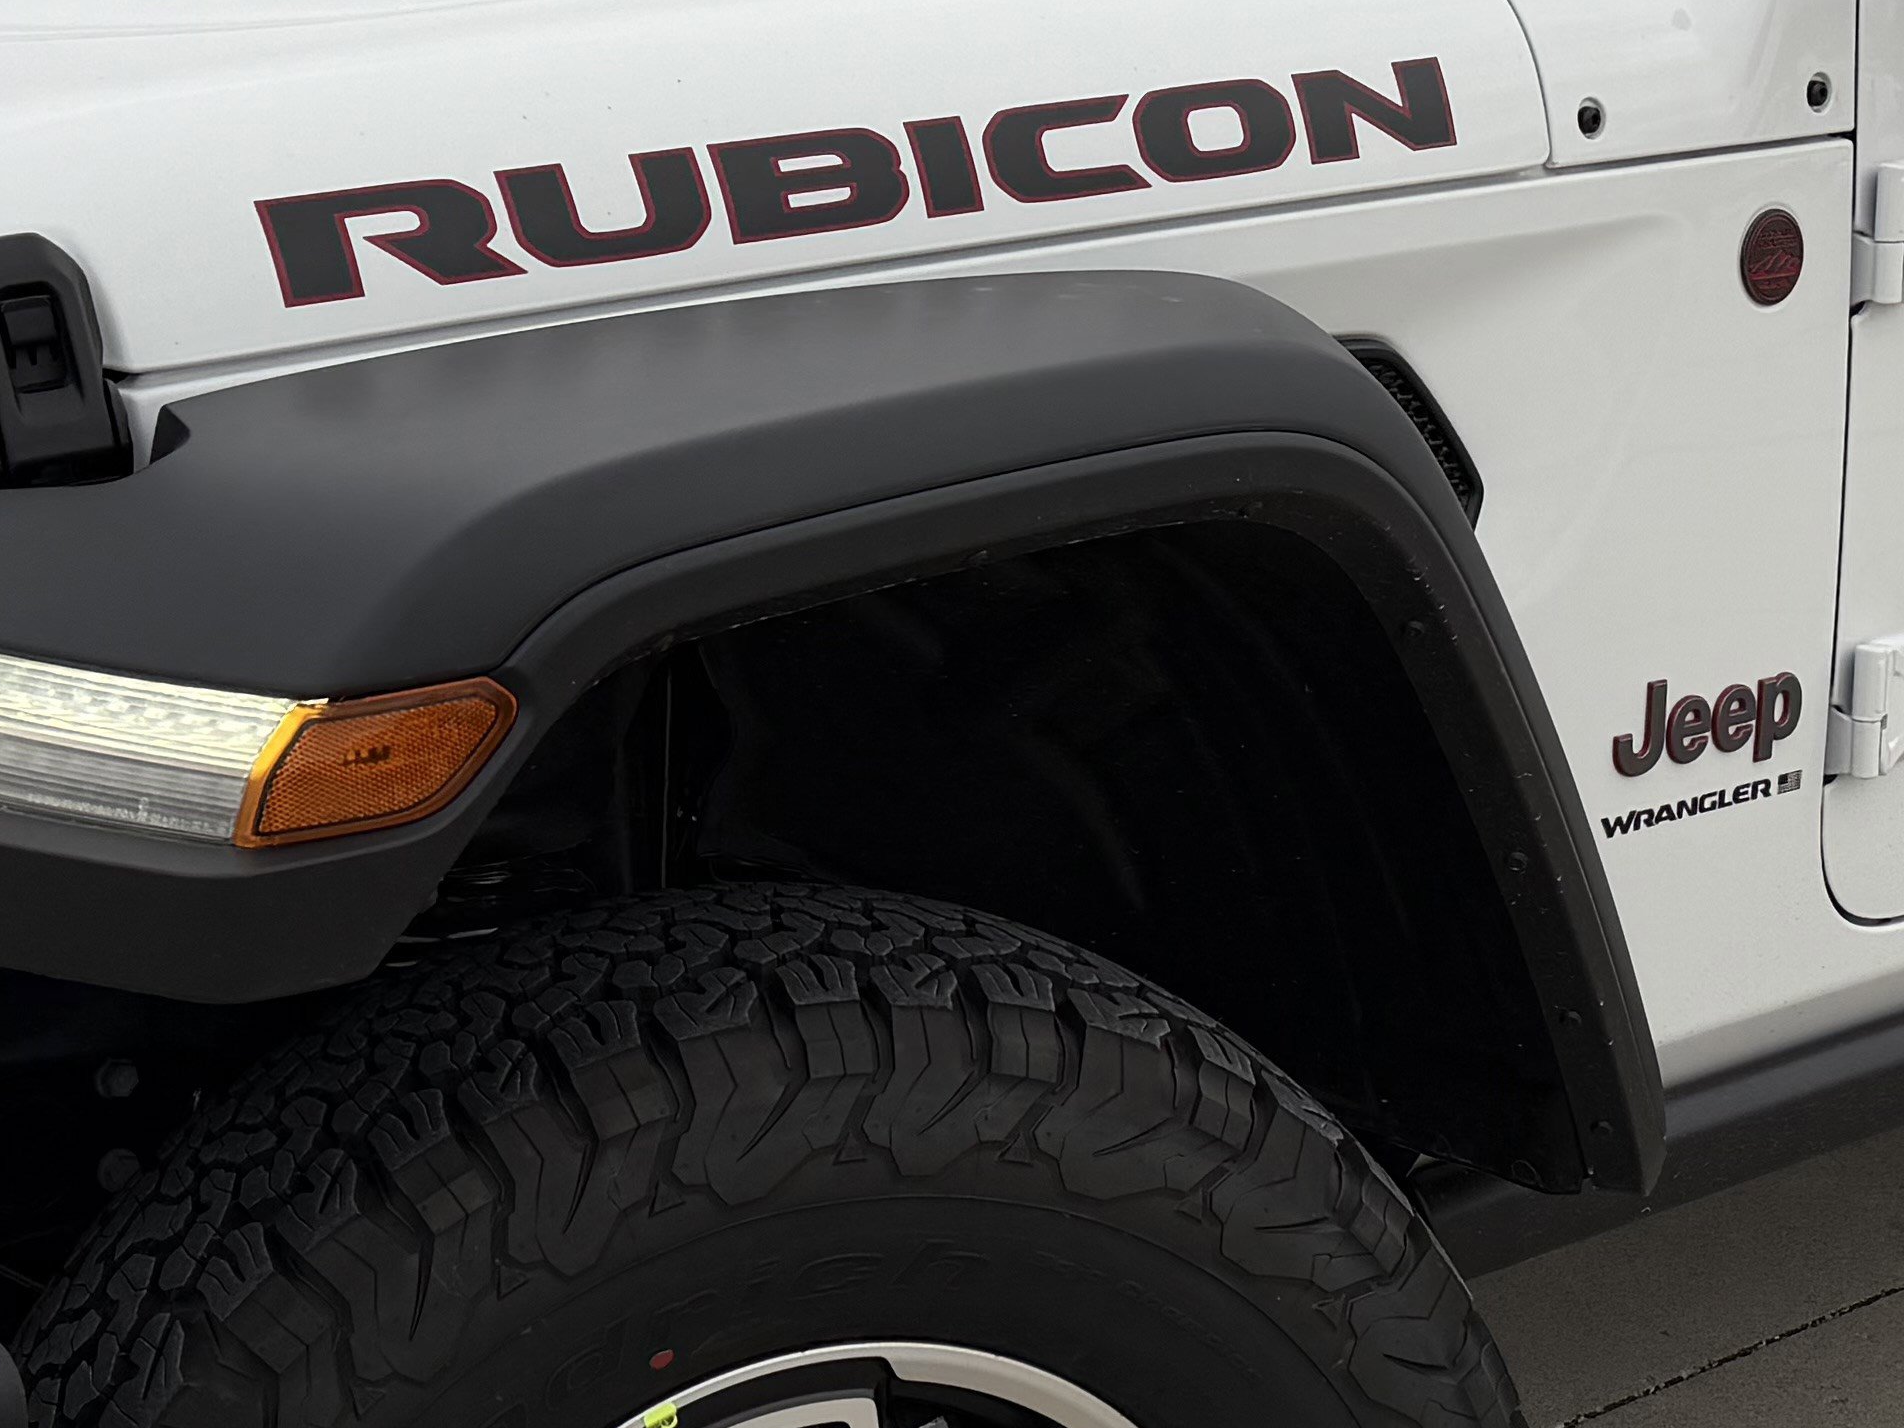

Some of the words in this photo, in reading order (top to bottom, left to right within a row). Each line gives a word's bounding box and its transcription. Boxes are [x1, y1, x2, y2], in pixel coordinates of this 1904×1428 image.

[254, 56, 1457, 308] RUBICON
[1612, 671, 1803, 778] Jeep
[1600, 778, 1772, 839] WRANGLER
